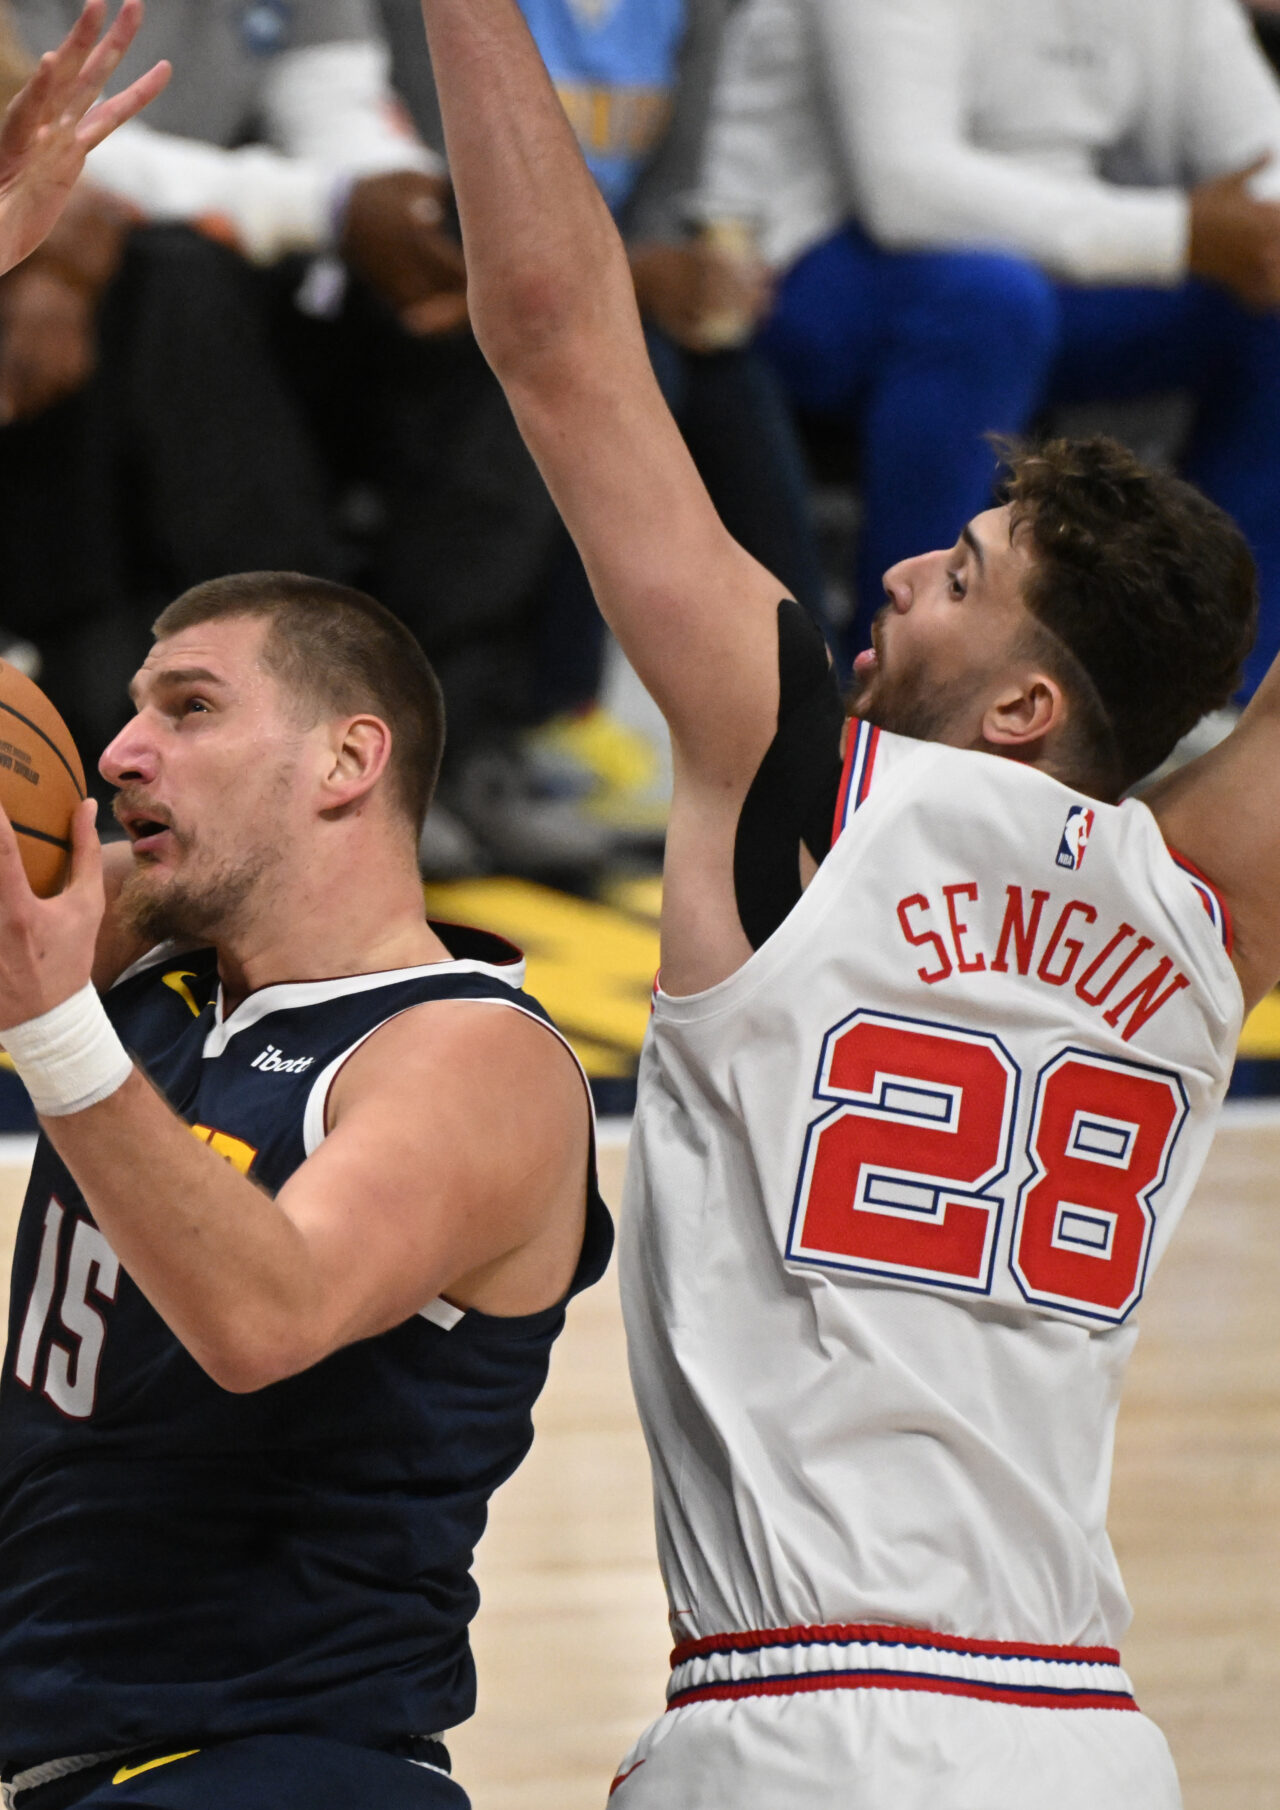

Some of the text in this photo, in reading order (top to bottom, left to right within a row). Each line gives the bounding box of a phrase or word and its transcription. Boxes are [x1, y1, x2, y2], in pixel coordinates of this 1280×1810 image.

[1058, 853, 1074, 867] NBA
[896, 882, 1191, 1042] SENGUN
[250, 1044, 316, 1074] ibott
[785, 1007, 1190, 1324] 28
[15, 1193, 120, 1421] 15
